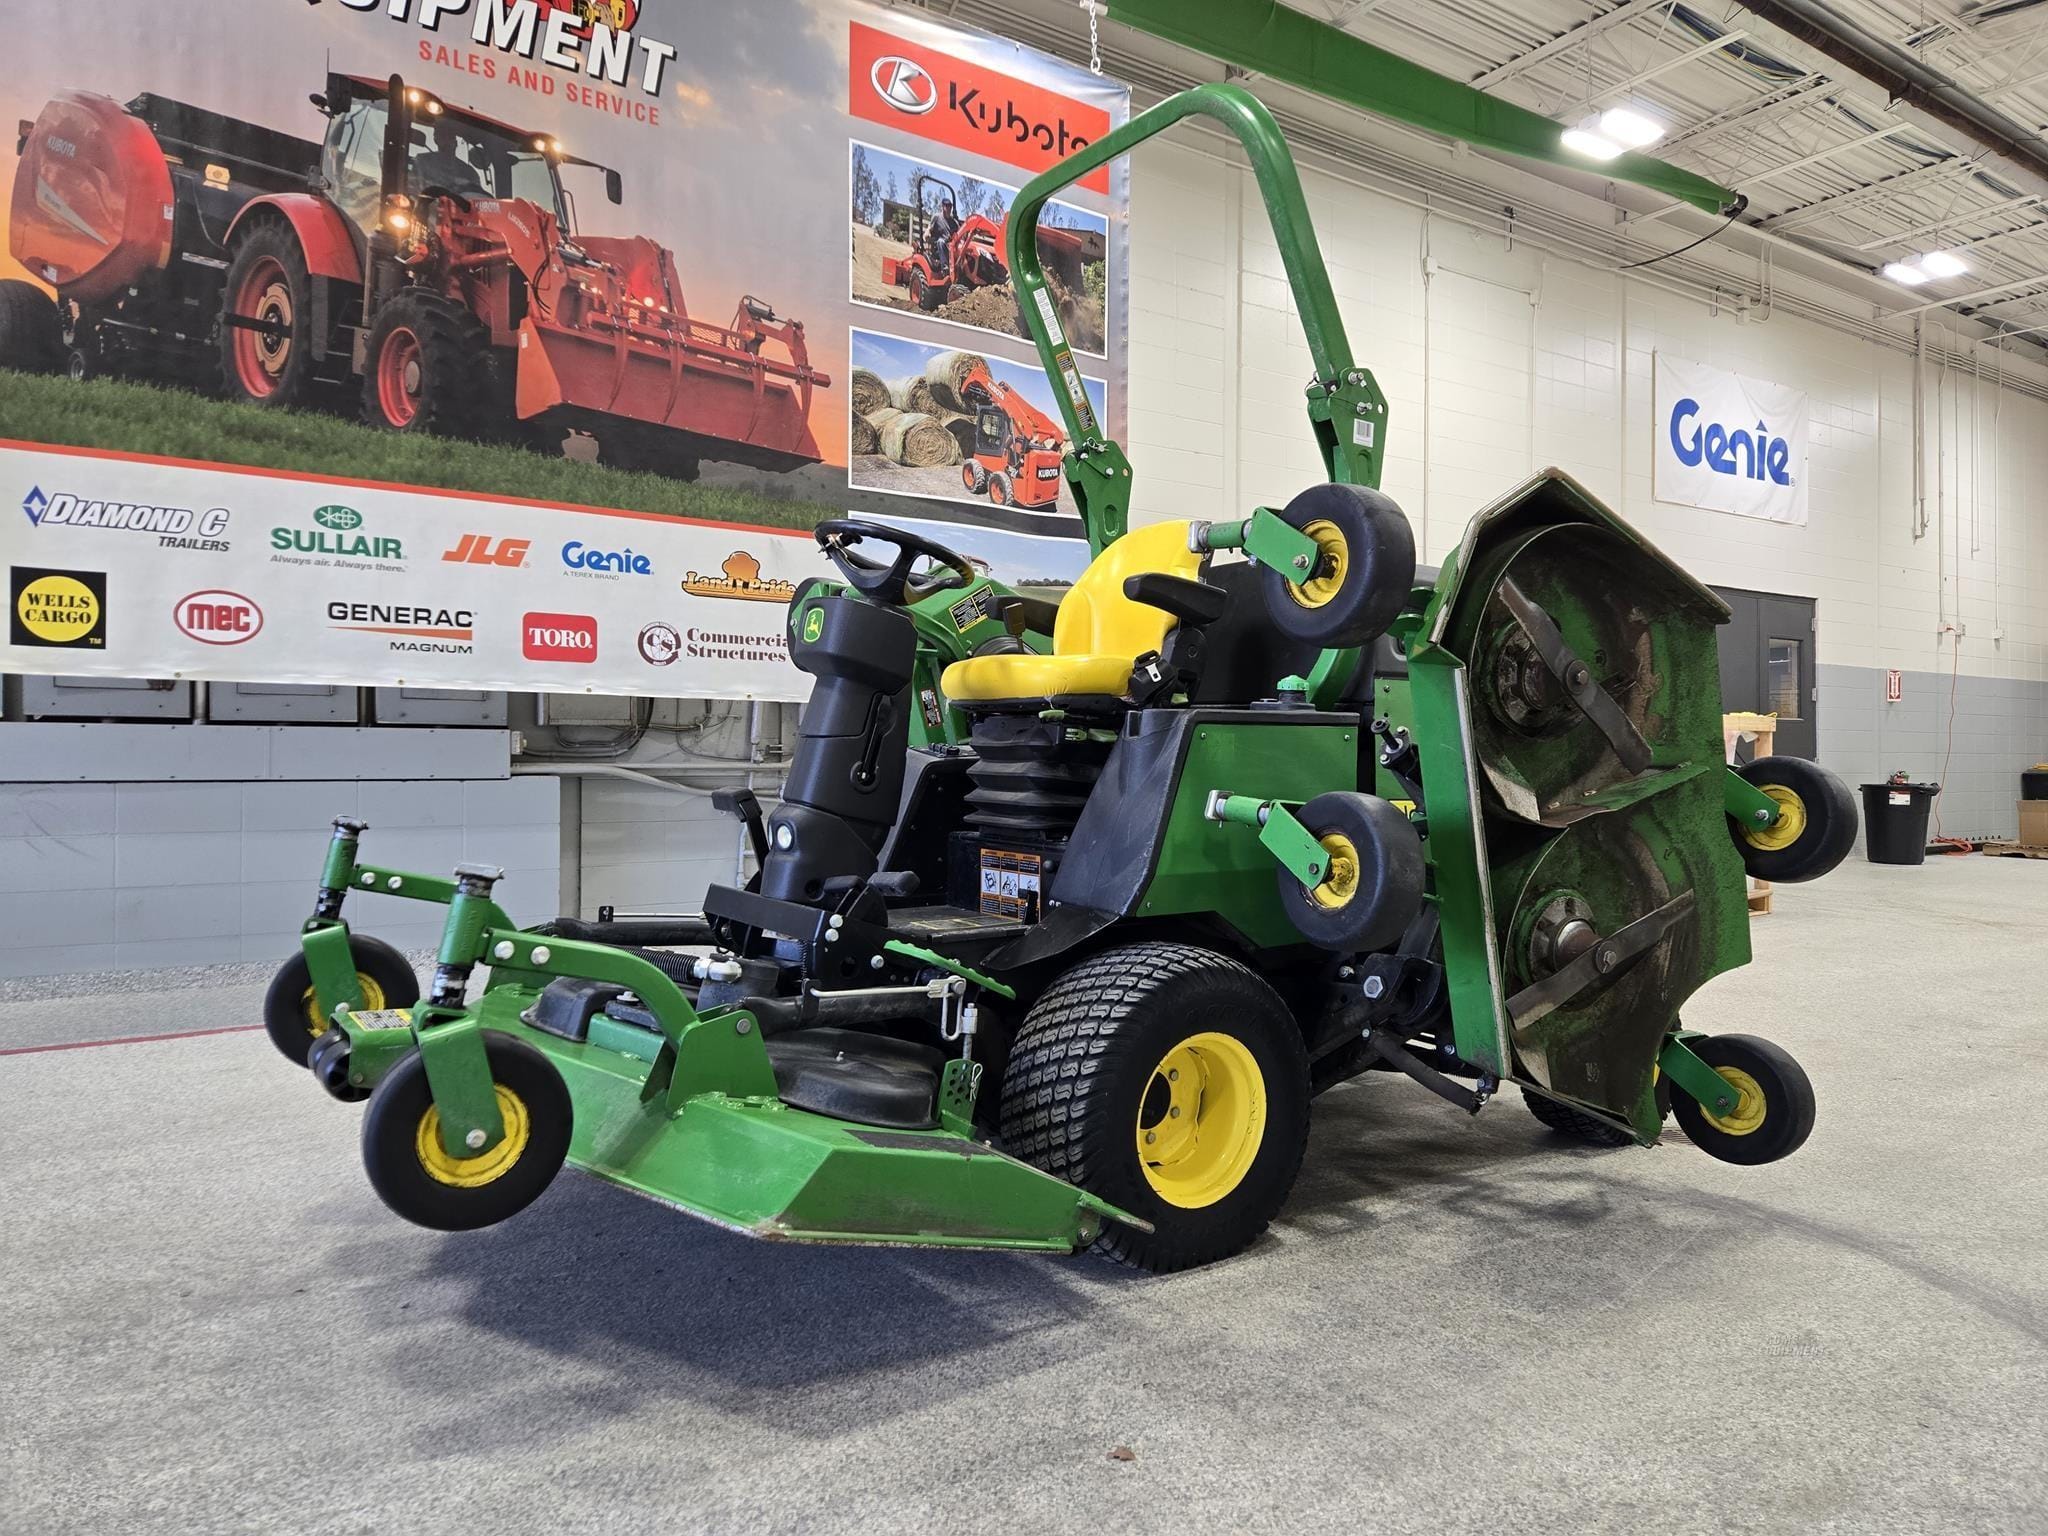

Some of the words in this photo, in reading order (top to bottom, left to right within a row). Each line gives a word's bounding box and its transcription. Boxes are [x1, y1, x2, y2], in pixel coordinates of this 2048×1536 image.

[419, 40, 497, 79] SALES
[507, 66, 555, 96] AND
[566, 82, 660, 126] SERVICE
[1670, 398, 1790, 486] Genie
[41, 493, 193, 534] DIAMOND
[198, 508, 230, 537] C
[158, 536, 230, 551] TRAILERS
[270, 527, 403, 559] SULLAIR
[441, 534, 531, 567] JLG
[270, 554, 312, 566] Always
[333, 560, 372, 571] Always
[562, 541, 651, 575] Genie
[684, 571, 735, 591] Land
[27, 593, 91, 608] WELLS
[25, 609, 92, 624] CARGO
[328, 602, 473, 628] GENERAC
[390, 642, 473, 654] MAGNUM
[529, 628, 592, 648] TORO
[687, 644, 786, 662] Structures
